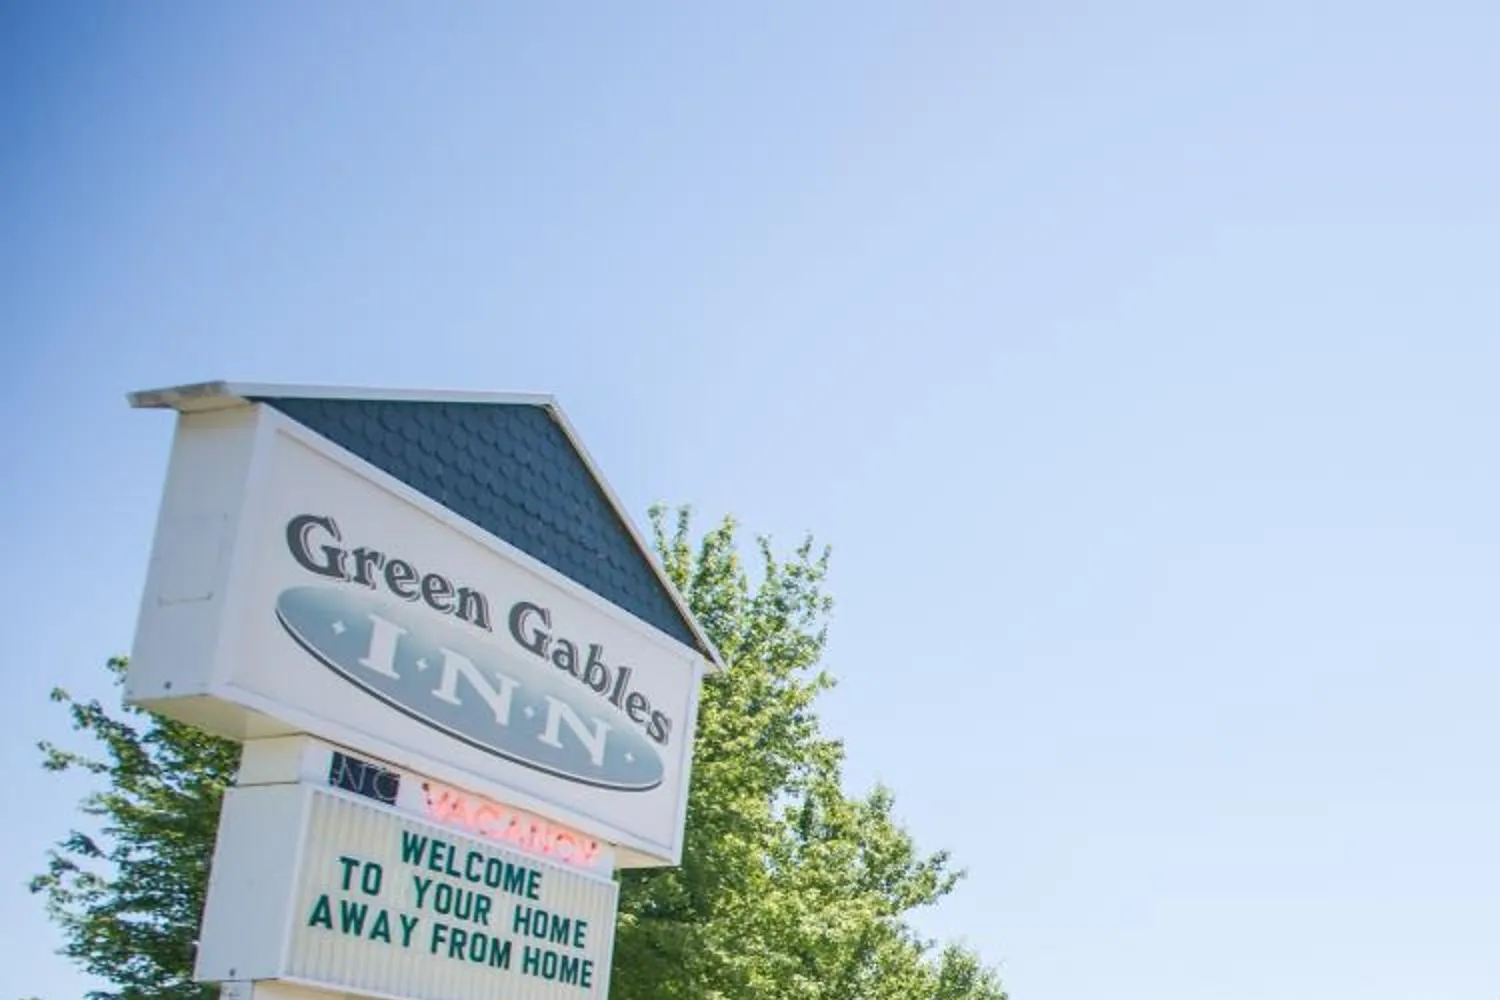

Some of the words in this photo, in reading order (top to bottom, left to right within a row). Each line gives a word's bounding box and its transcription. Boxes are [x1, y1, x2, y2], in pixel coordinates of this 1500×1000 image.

[286, 514, 492, 633] Green
[508, 601, 672, 745] Gables
[402, 830, 542, 900] WELCOME
[421, 782, 600, 869] VACANCY
[308, 894, 420, 948] AWAY
[431, 923, 513, 971] FROM
[522, 945, 594, 989] HOME
[340, 856, 383, 896] TO
[414, 875, 492, 926] YOUR
[513, 904, 588, 949] HOME
